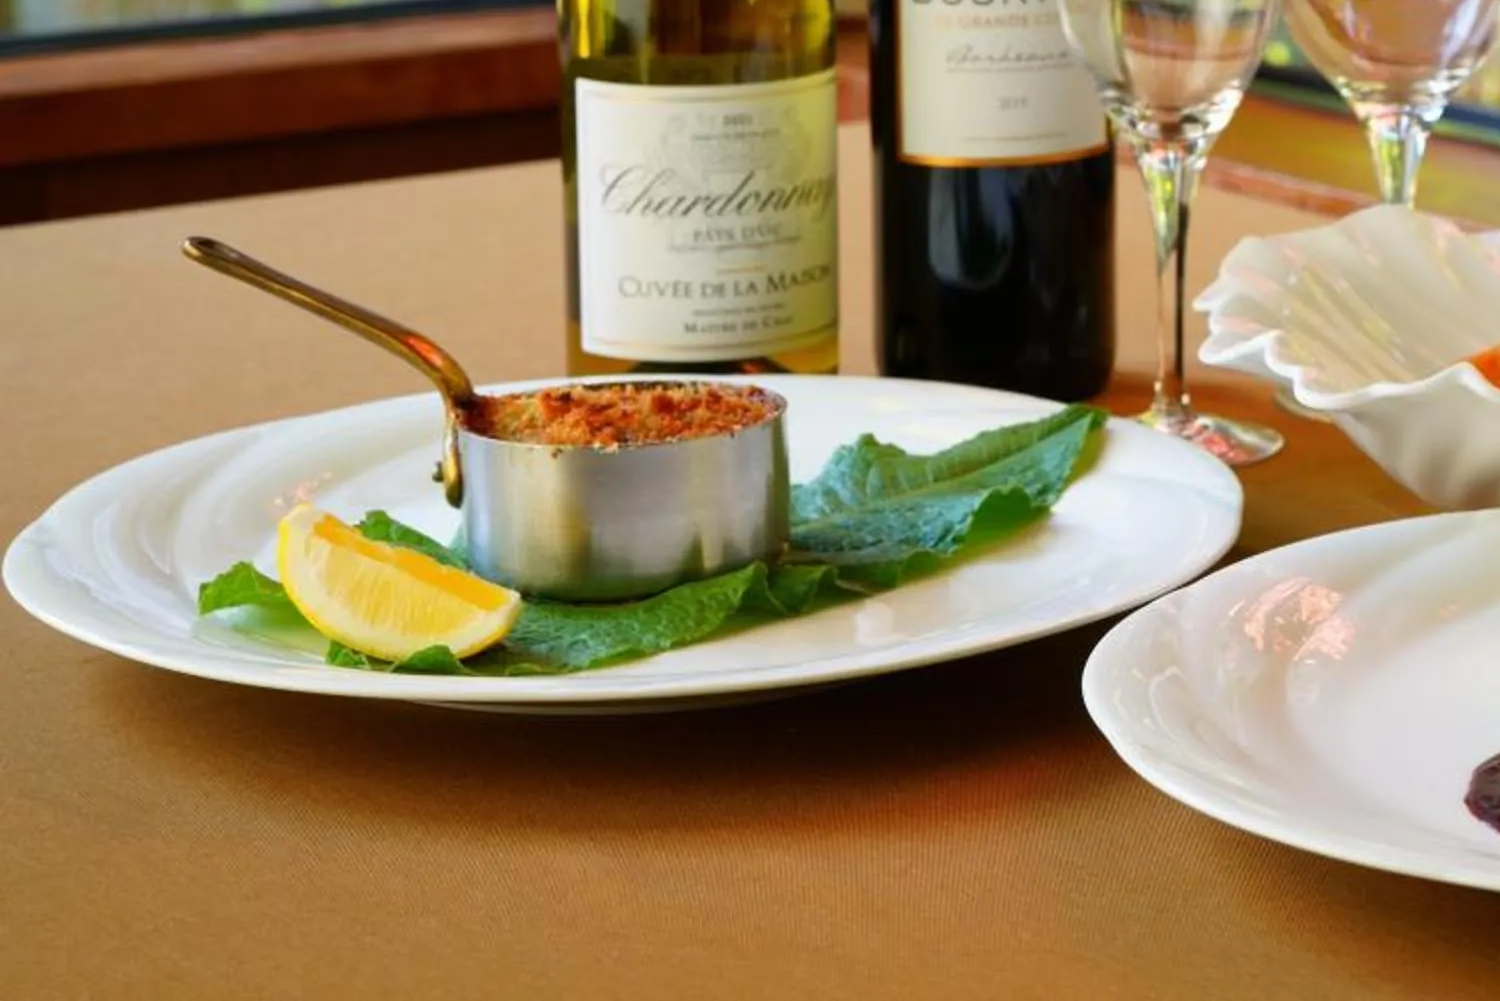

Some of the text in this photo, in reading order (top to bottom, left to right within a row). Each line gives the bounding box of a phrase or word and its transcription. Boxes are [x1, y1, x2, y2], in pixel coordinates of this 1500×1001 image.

[602, 165, 836, 224] Chardonnay
[701, 284, 727, 299] DE
[733, 279, 758, 296] LA
